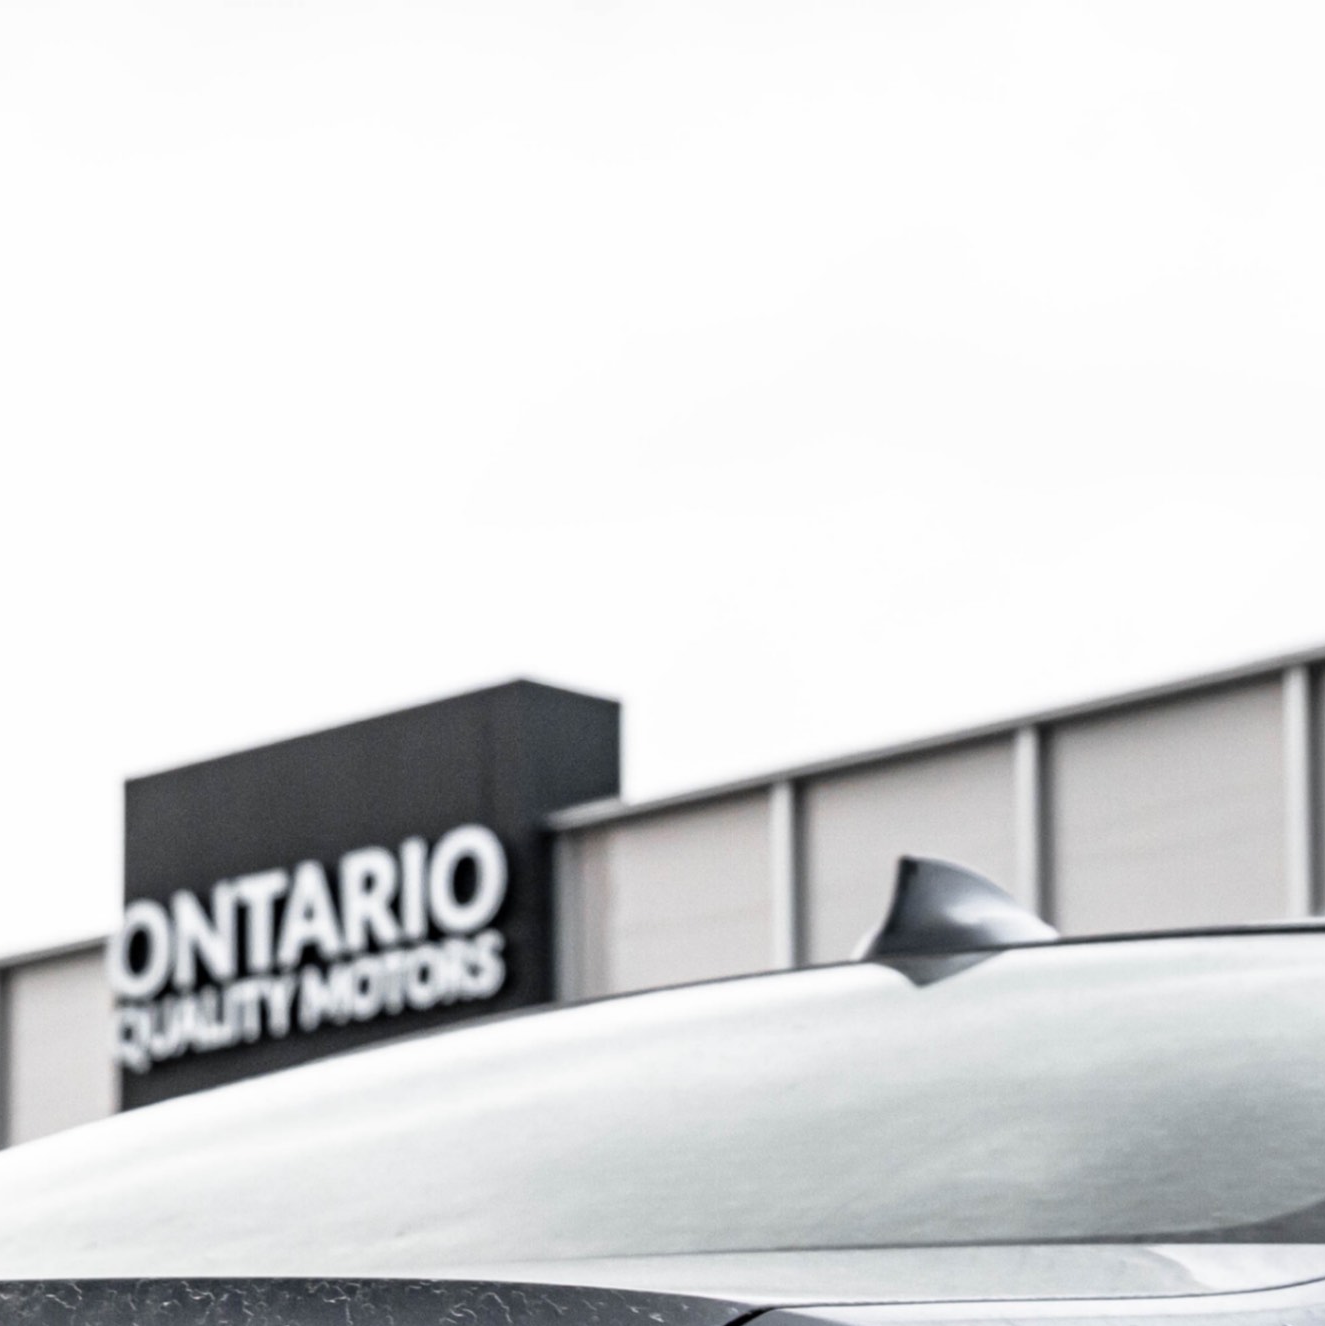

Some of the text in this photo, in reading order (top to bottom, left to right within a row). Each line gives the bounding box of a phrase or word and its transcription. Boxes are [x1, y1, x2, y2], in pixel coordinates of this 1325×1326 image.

[109, 823, 508, 998] ONTARIO
[112, 928, 506, 1074] QUALITY MOTORS
